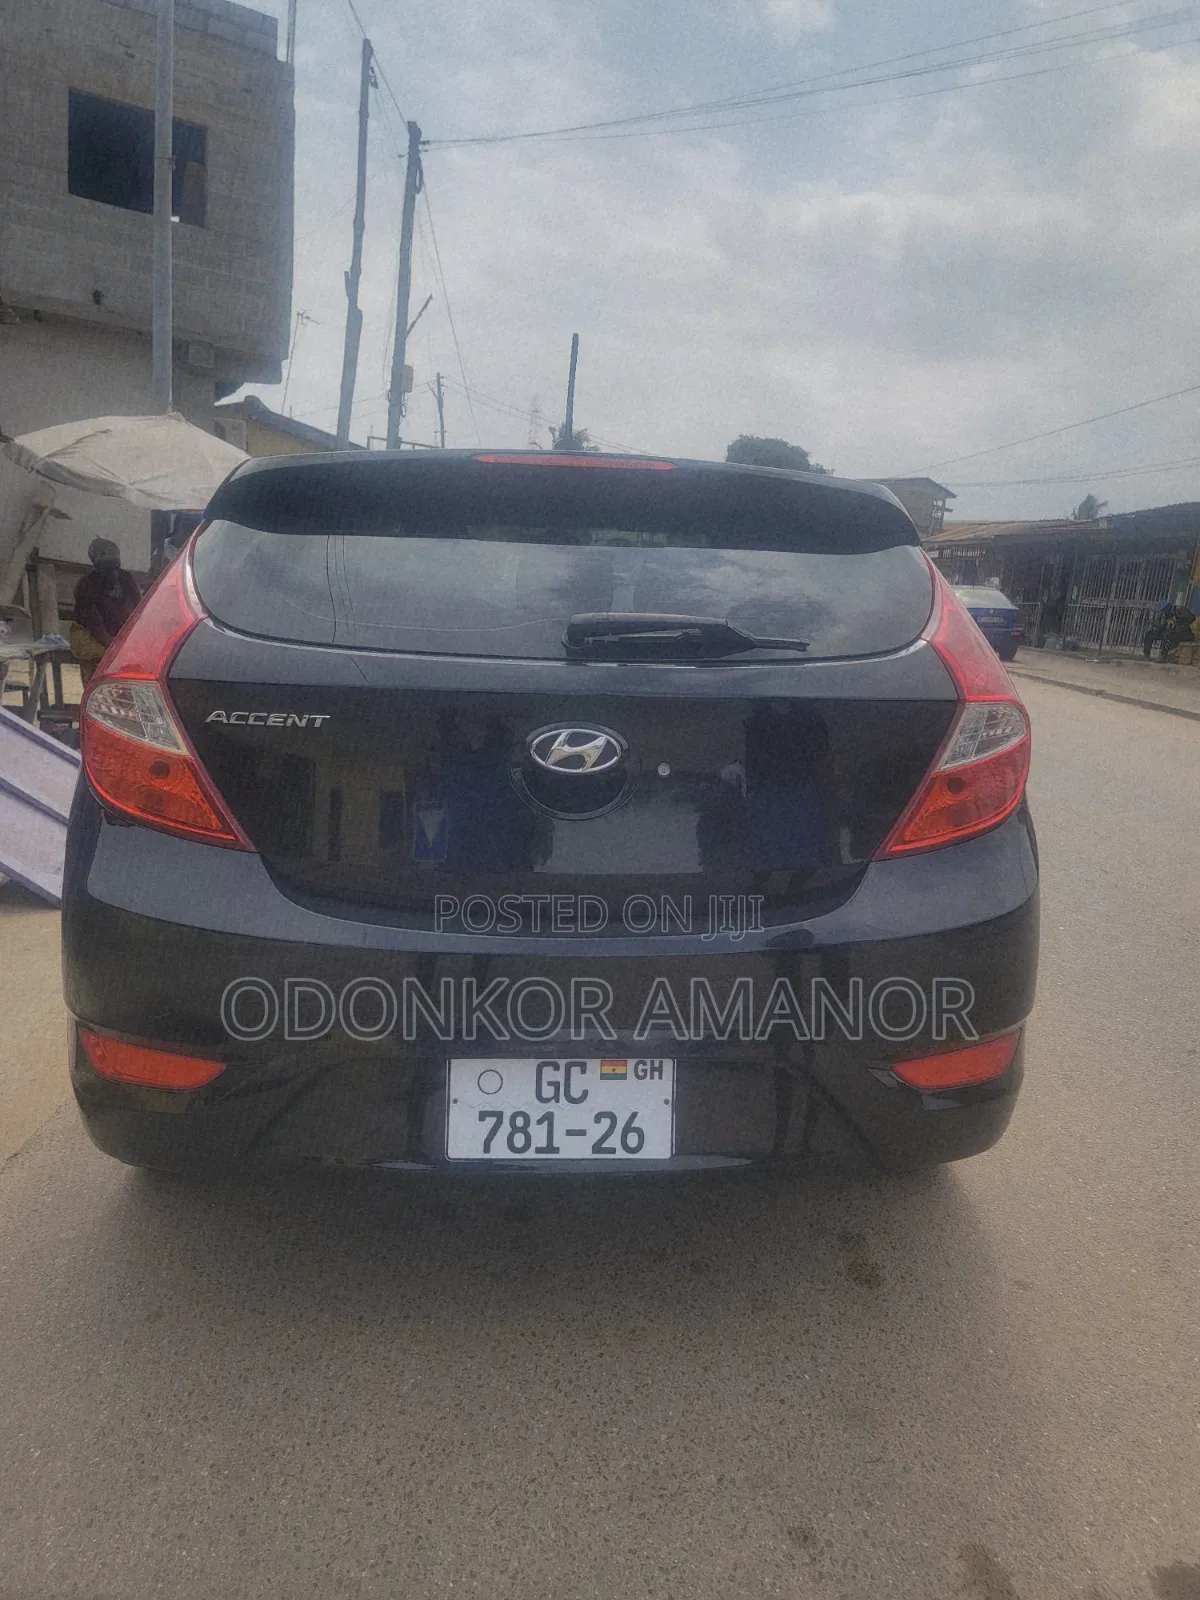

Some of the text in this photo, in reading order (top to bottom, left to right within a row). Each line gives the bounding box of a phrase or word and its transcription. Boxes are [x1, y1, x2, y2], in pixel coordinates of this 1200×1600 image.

[204, 710, 331, 728] ACCENT
[535, 1061, 589, 1105] GC
[634, 1060, 664, 1081] GH
[478, 1110, 645, 1154] 781-26
